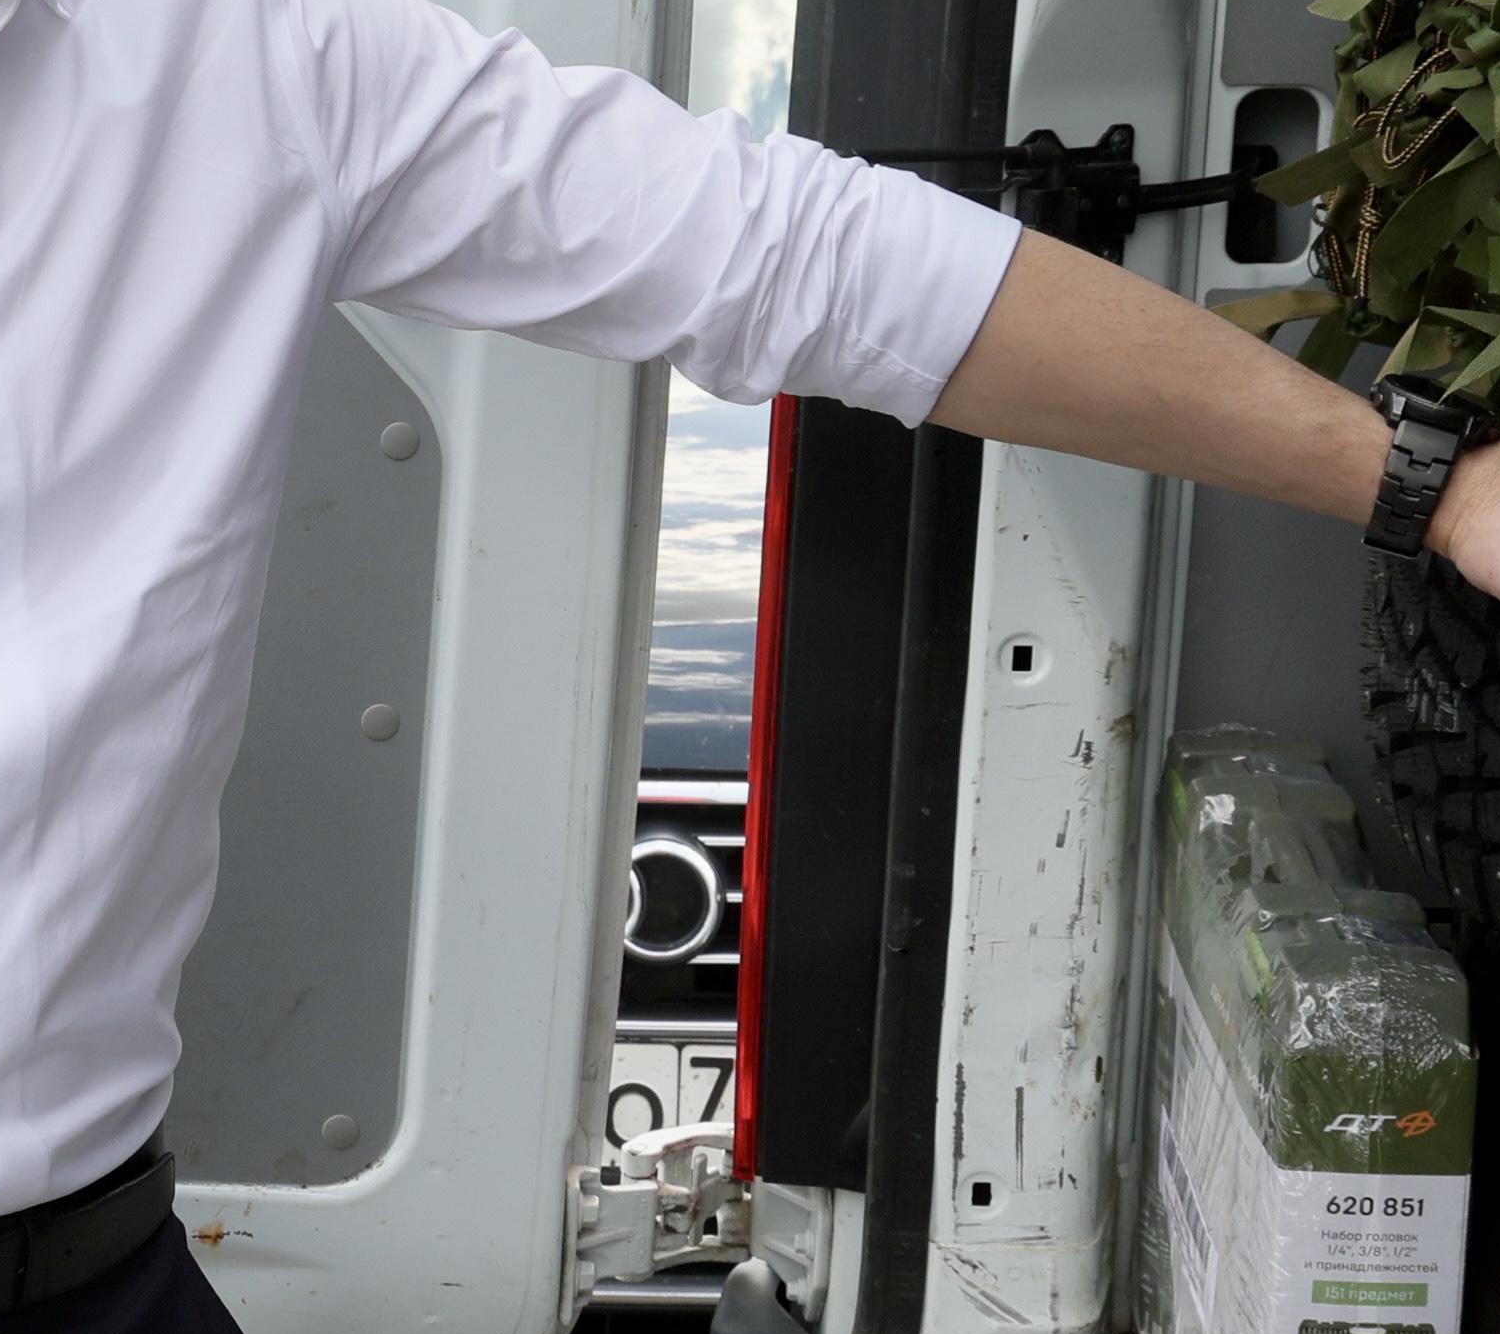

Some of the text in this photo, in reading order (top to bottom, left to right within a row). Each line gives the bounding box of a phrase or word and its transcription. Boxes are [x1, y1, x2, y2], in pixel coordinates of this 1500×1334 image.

[1326, 1196, 1424, 1217] 620 851
[1321, 1229, 1419, 1243] Набор головок
[1304, 1261, 1439, 1273] и принадлежностей
[1325, 1287, 1415, 1302] 151 предмет
